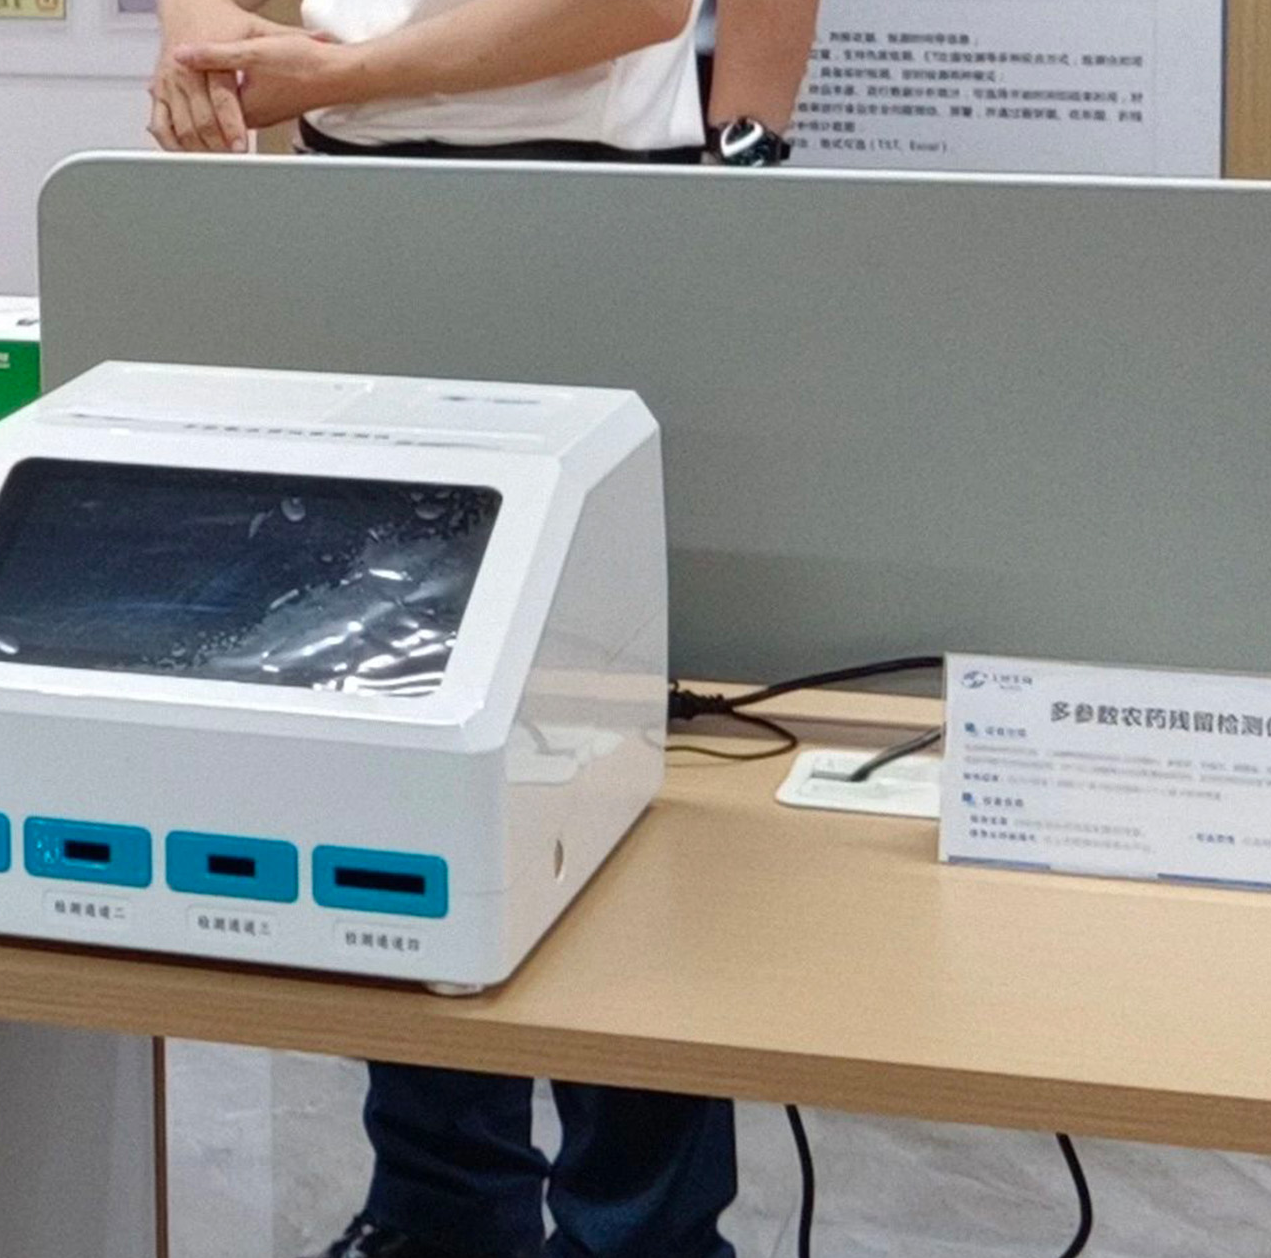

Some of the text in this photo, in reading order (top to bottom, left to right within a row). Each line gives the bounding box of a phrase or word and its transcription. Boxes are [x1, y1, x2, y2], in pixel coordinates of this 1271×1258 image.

[54, 899, 126, 920] 检测通道二
[345, 931, 420, 952] 检测通道四
